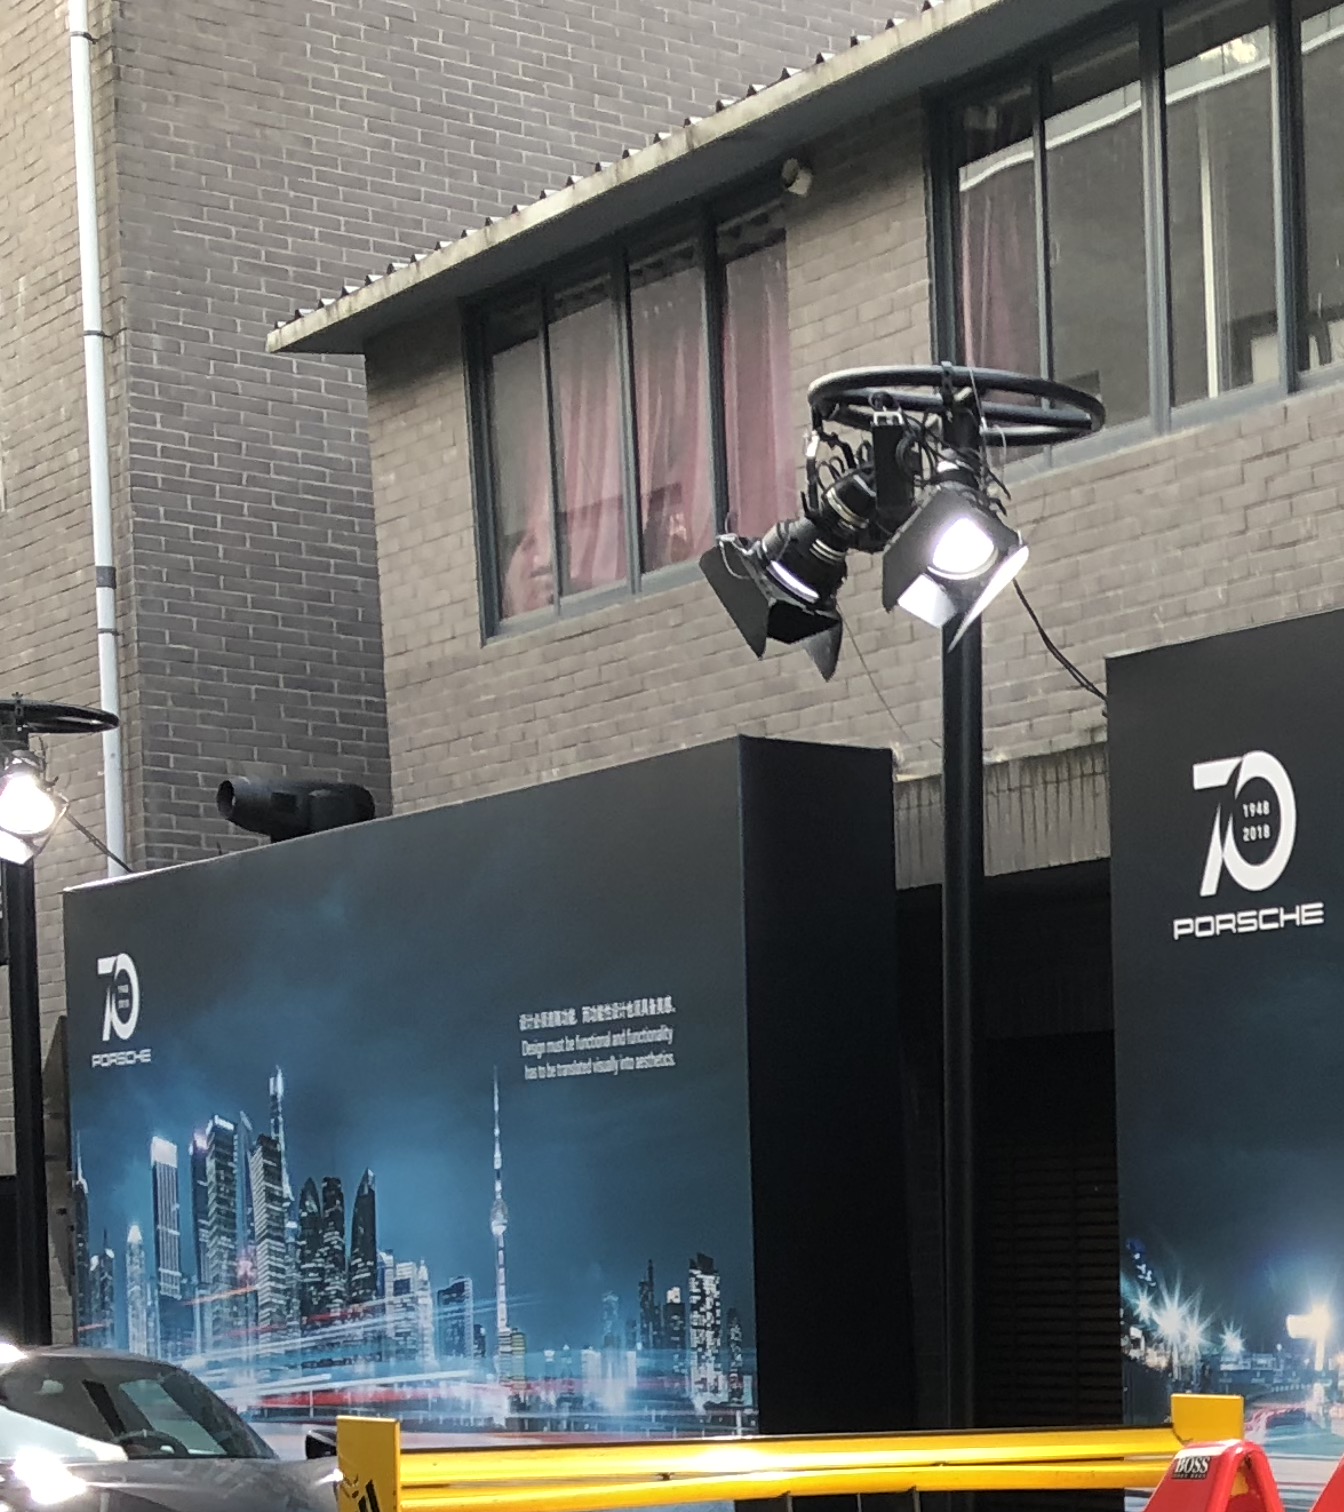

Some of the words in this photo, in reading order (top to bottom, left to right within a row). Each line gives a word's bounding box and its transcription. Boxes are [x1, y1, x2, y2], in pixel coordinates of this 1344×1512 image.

[1242, 800, 1270, 818] 1948
[1192, 750, 1297, 897] 70
[1242, 823, 1271, 842] 2018
[1172, 902, 1325, 940] PORSCHE
[97, 953, 140, 1042] 70
[521, 1040, 546, 1059] Design
[547, 1038, 565, 1053] must
[566, 1035, 575, 1051] be
[576, 1031, 611, 1050] functional
[612, 1029, 626, 1046] and
[627, 1025, 673, 1045] functionality
[91, 1048, 152, 1068] PORSCHE
[525, 1064, 538, 1080] has
[538, 1064, 546, 1078] to
[546, 1062, 557, 1078] be
[557, 1057, 592, 1077] translated
[592, 1055, 619, 1075] visually
[620, 1054, 635, 1070] into
[1174, 1456, 1210, 1473] BOSS
